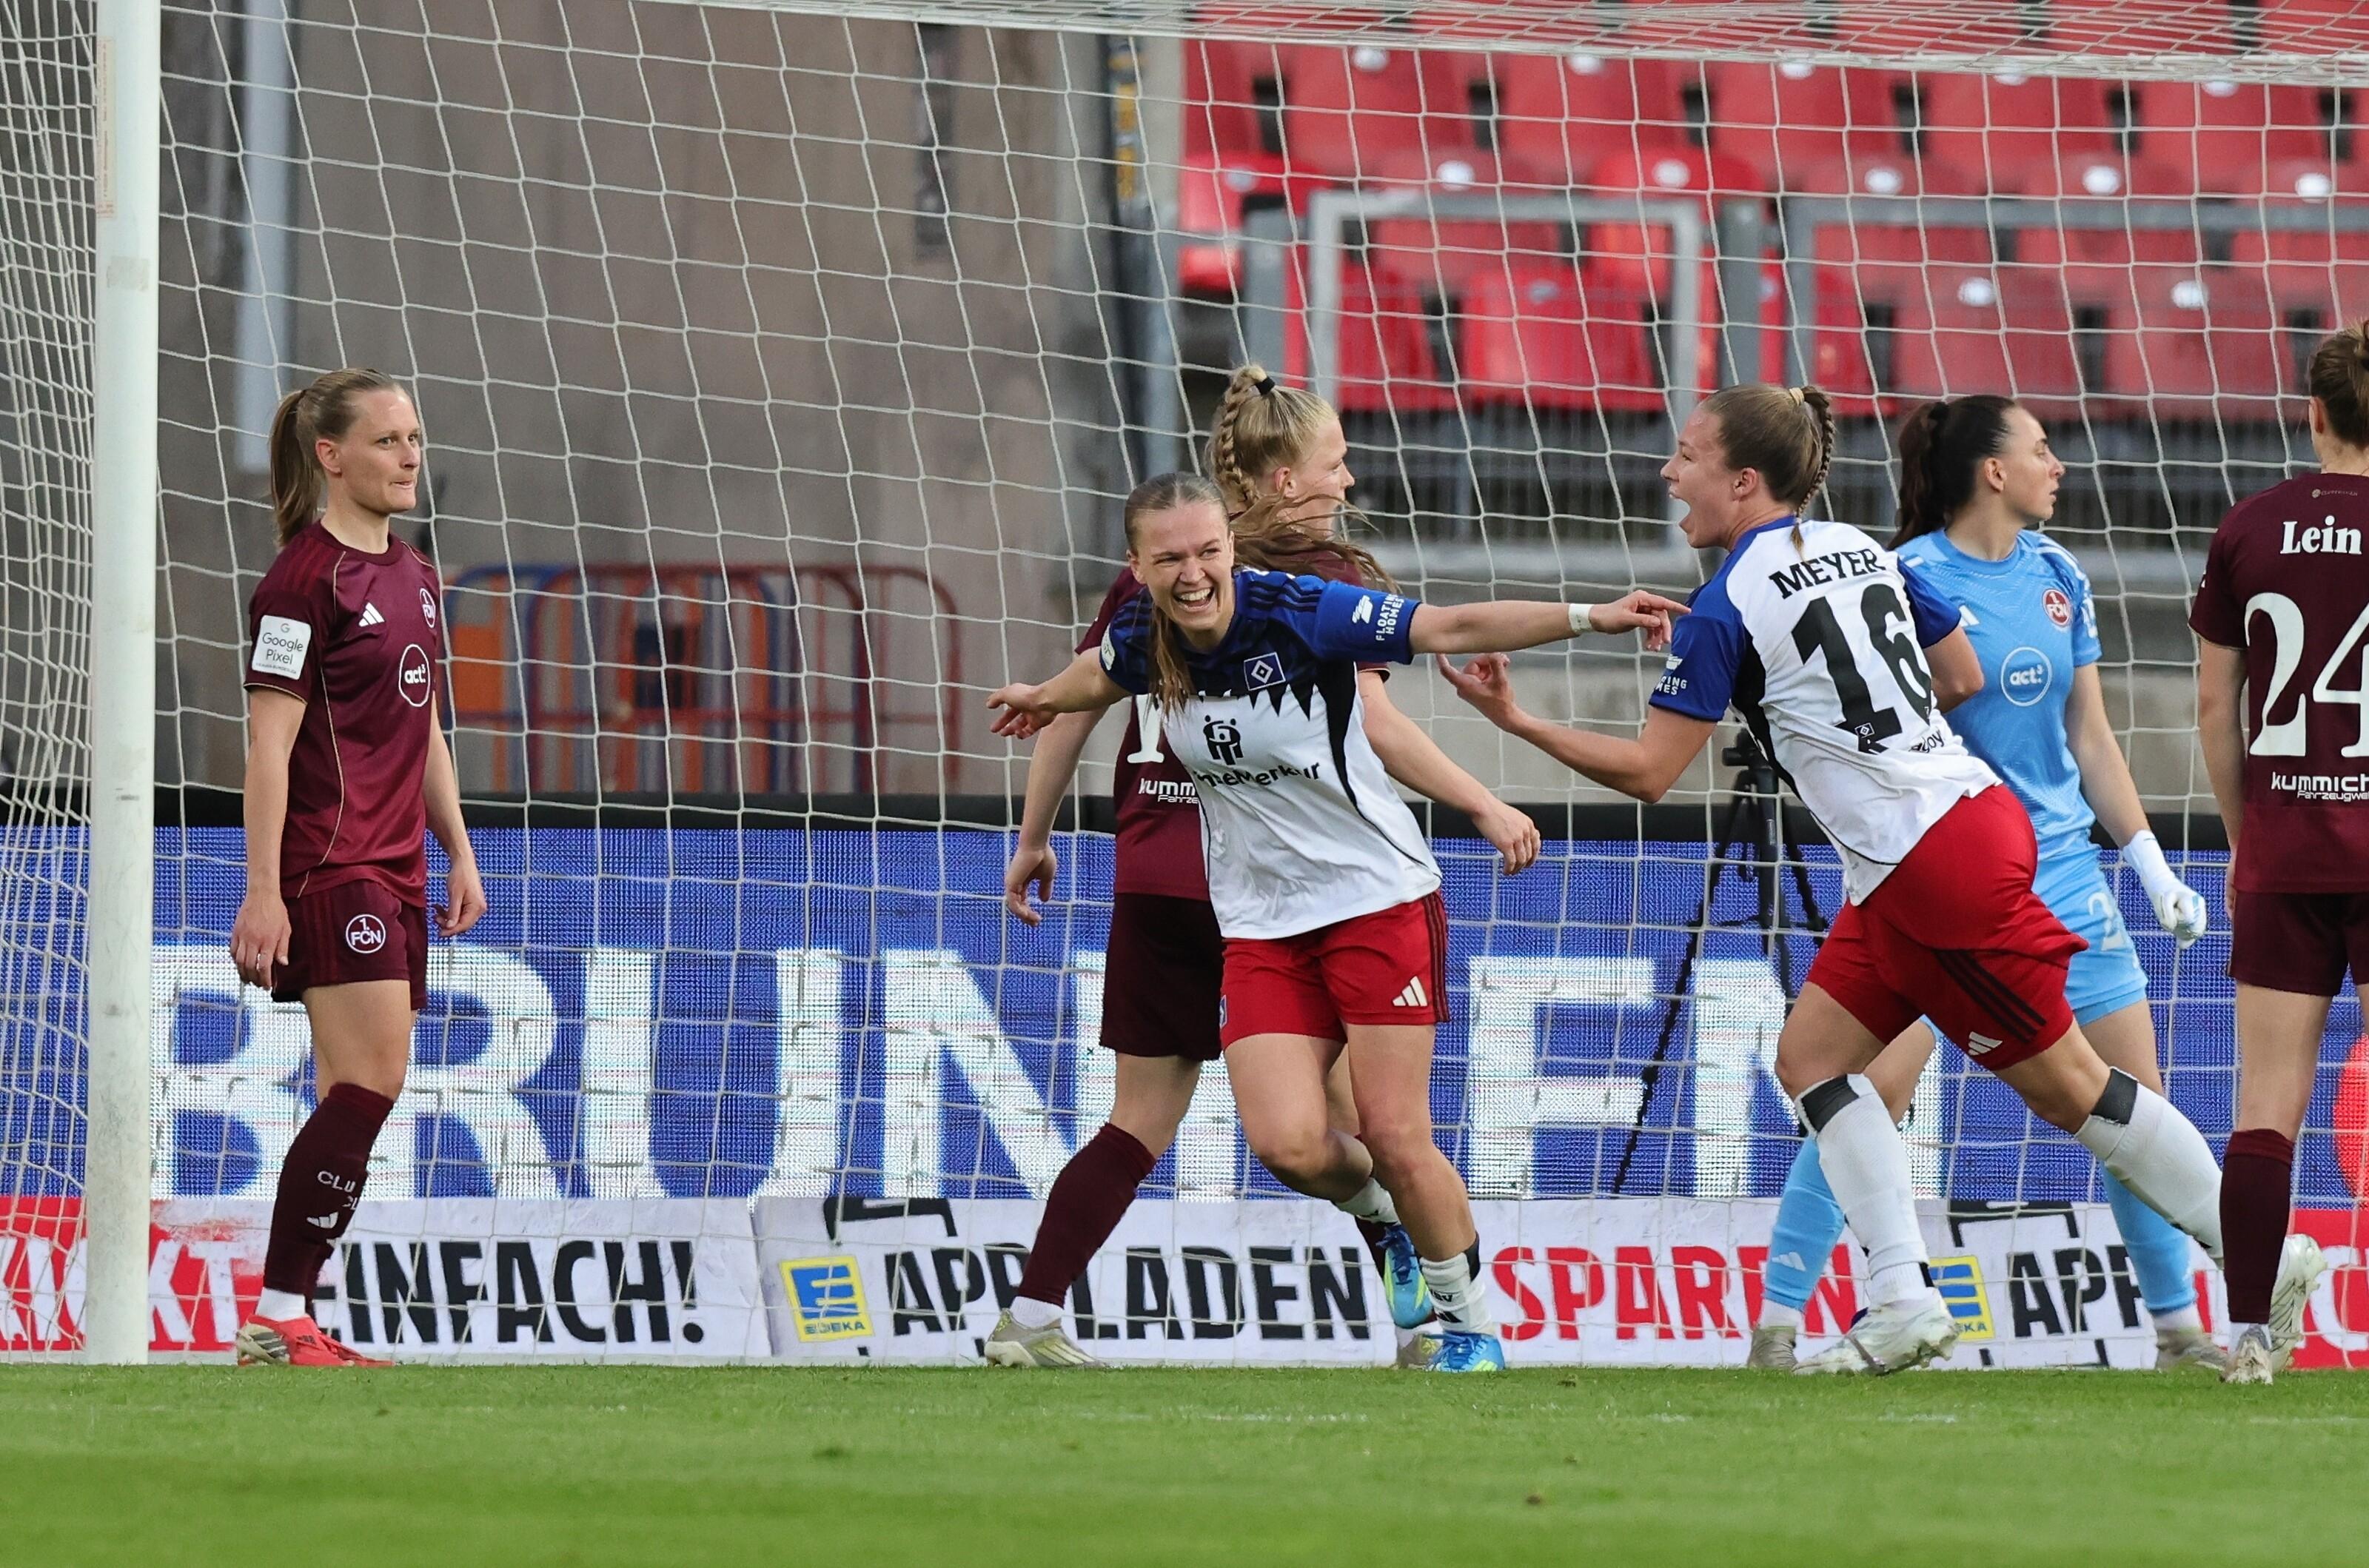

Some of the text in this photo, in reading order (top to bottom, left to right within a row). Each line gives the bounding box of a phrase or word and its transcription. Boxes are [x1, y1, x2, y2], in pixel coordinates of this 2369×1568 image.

[2280, 515, 2362, 555] Lein
[1769, 549, 1886, 600] MEYER
[1386, 597, 1404, 634] HOMES
[262, 632, 303, 652] Google
[266, 649, 293, 665] Pixel
[1792, 583, 1931, 753] 16
[2245, 592, 2369, 757] 24
[2297, 790, 2369, 802] Fahrzeugwe
[351, 930, 381, 945] FCN
[359, 917, 370, 931] 1.
[311, 1240, 705, 1344] INFACH!
[1070, 1246, 1370, 1340] LADEN
